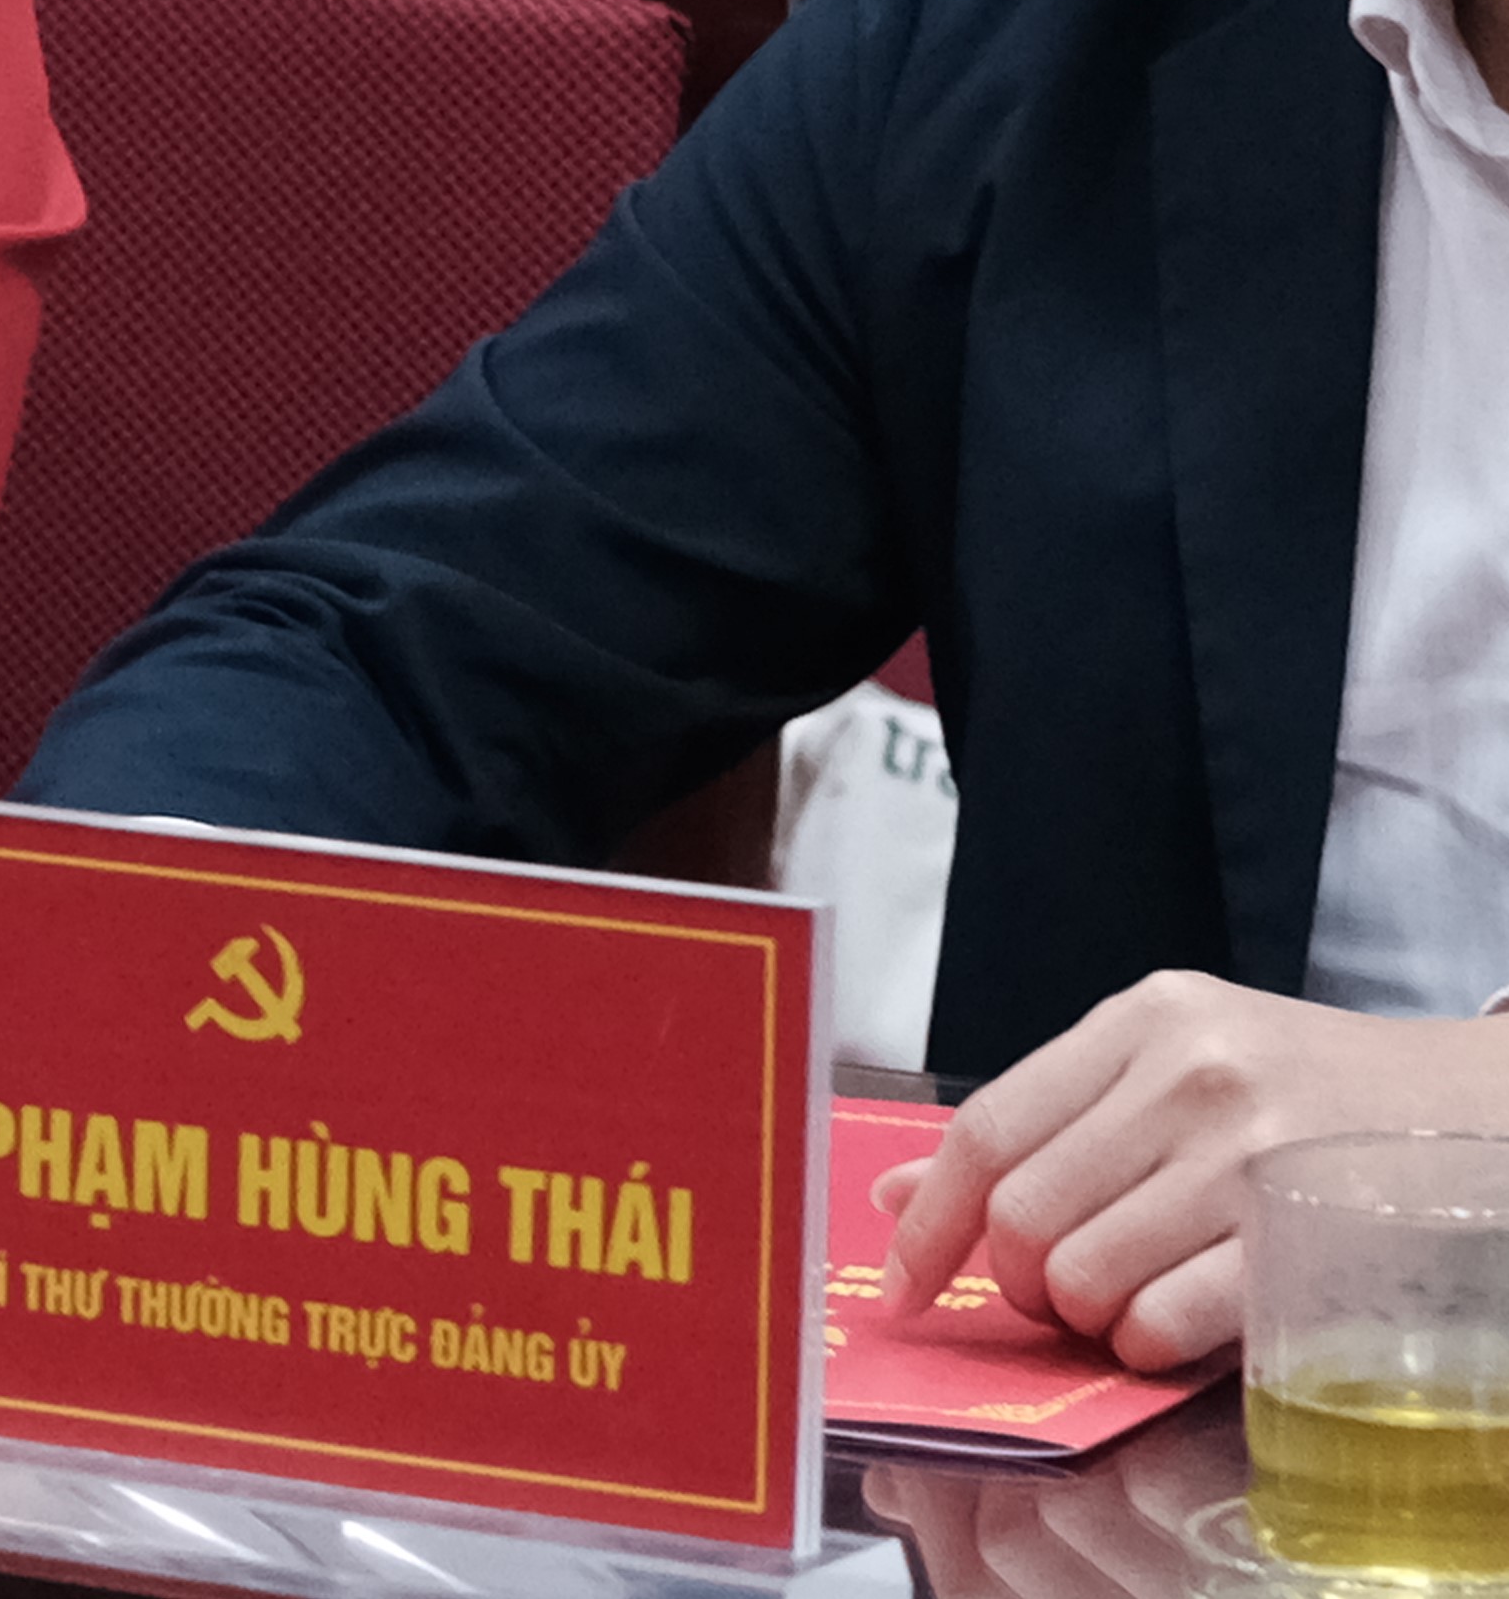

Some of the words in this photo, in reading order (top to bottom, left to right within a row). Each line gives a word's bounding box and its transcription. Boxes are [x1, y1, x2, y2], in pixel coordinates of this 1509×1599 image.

[238, 1120, 470, 1256] HÙNG
[498, 1161, 692, 1284] THÁI
[20, 1262, 109, 1320] THƯ
[115, 1274, 290, 1346] THƯỜNG
[303, 1300, 417, 1369] TRỰC
[431, 1303, 555, 1382] ĐẢNG
[569, 1317, 626, 1391] ỦY
